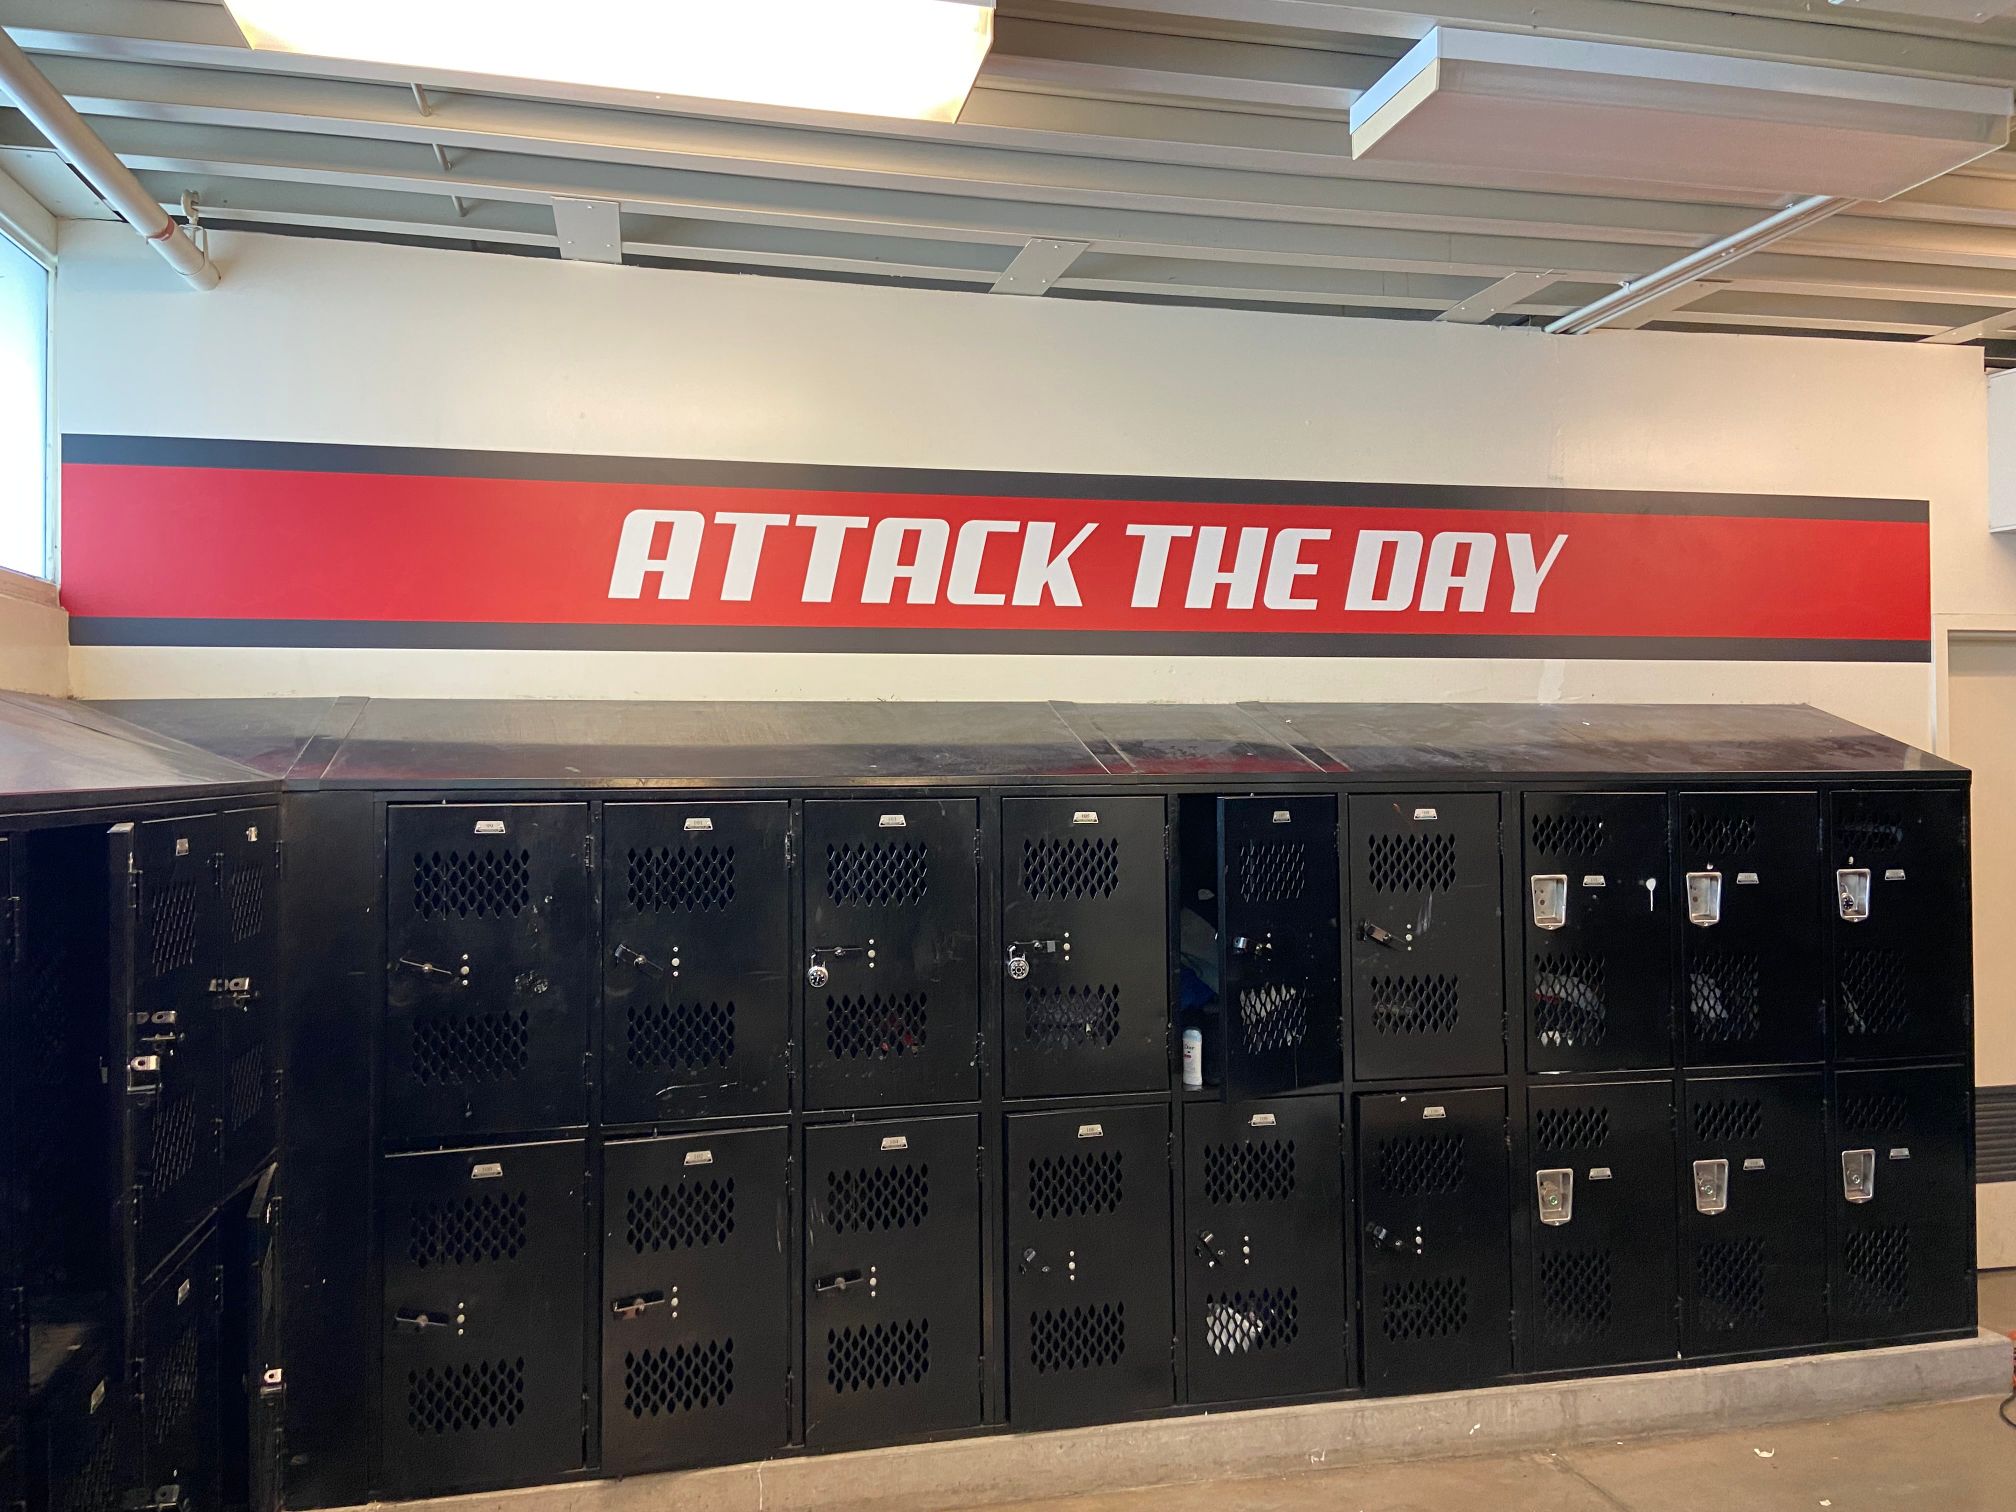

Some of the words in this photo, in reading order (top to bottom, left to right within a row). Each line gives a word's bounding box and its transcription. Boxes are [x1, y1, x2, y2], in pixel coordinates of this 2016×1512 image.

[608, 509, 1099, 606] ATTACK
[1126, 524, 1332, 610] THE
[1345, 530, 1568, 613] DAY
